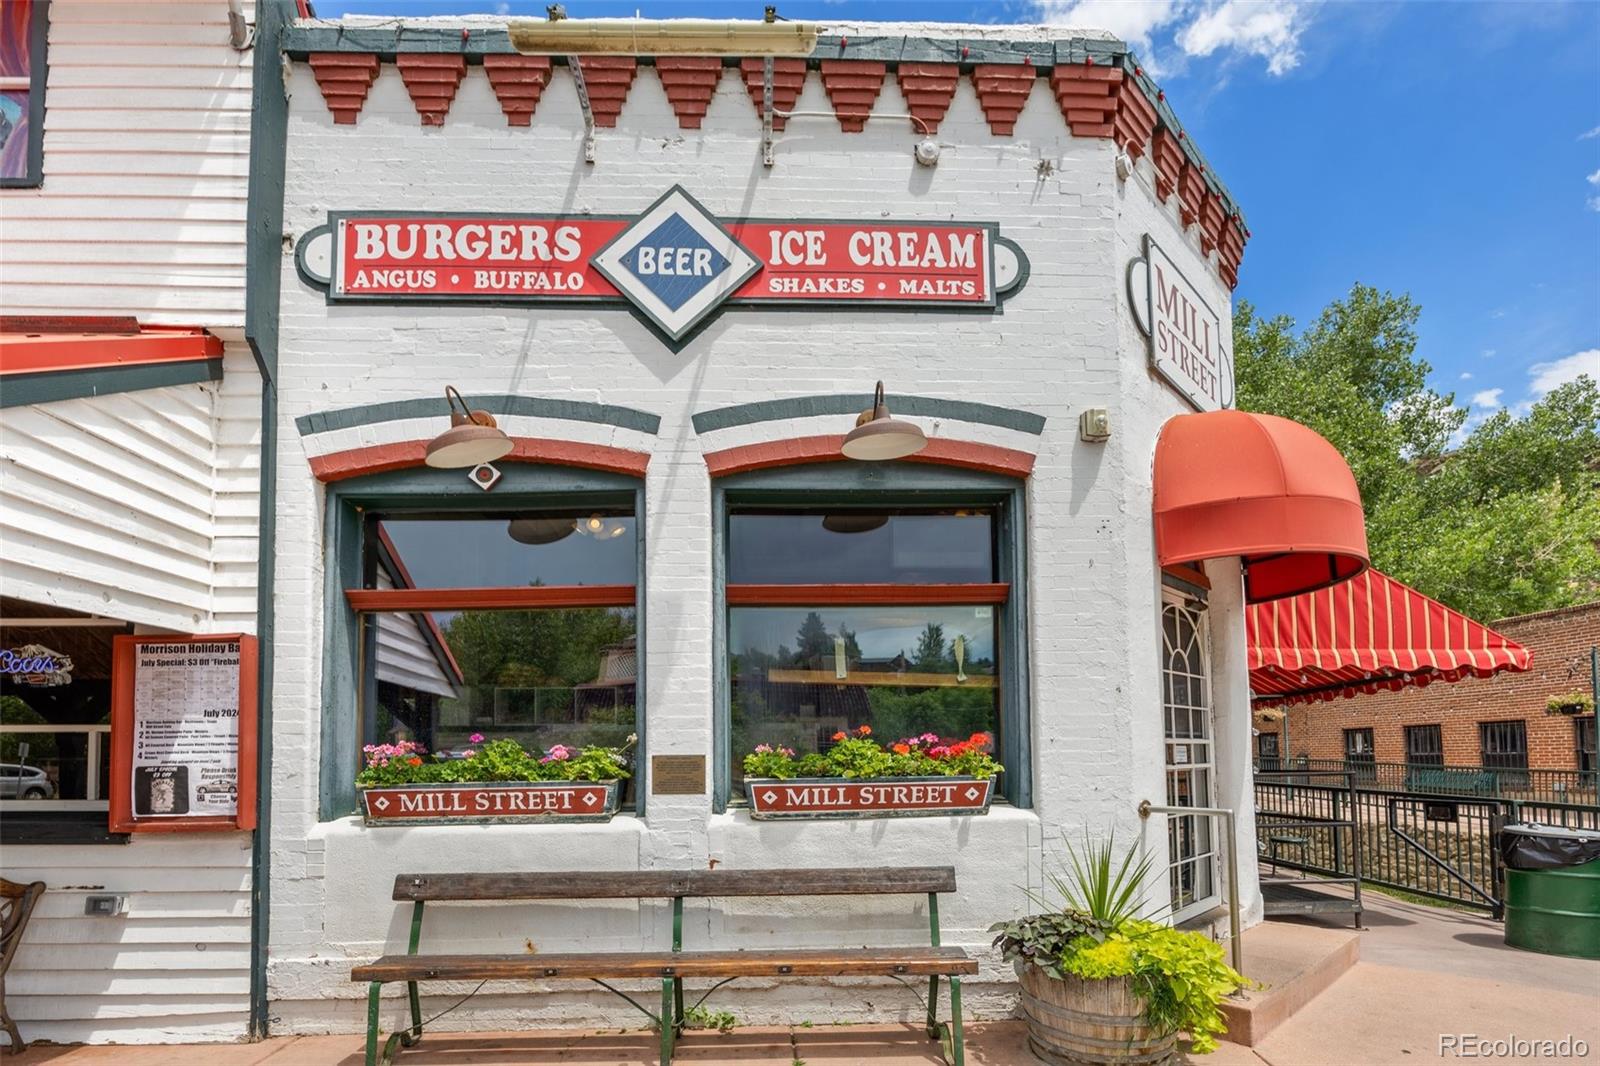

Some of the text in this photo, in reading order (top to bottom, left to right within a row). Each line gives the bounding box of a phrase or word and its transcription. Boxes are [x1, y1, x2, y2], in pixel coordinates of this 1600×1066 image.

[354, 223, 582, 262] BURGERS
[768, 230, 977, 269] ICE CREAM
[638, 246, 713, 277] BEER
[352, 270, 584, 291] ANGUS BUFFALO
[768, 278, 976, 296] SHAKES MALTS
[1155, 263, 1215, 368] MILL
[1157, 319, 1217, 402] STREET
[140, 645, 186, 654] Morrison
[188, 644, 226, 654] Holiday
[141, 659, 155, 667] July
[156, 658, 186, 667] Special:
[188, 658, 198, 667] $3
[203, 709, 220, 718] July
[138, 741, 144, 749] 3
[139, 731, 144, 739] 2
[398, 790, 576, 812] MILL STREET
[785, 785, 957, 807] MILL STREET
